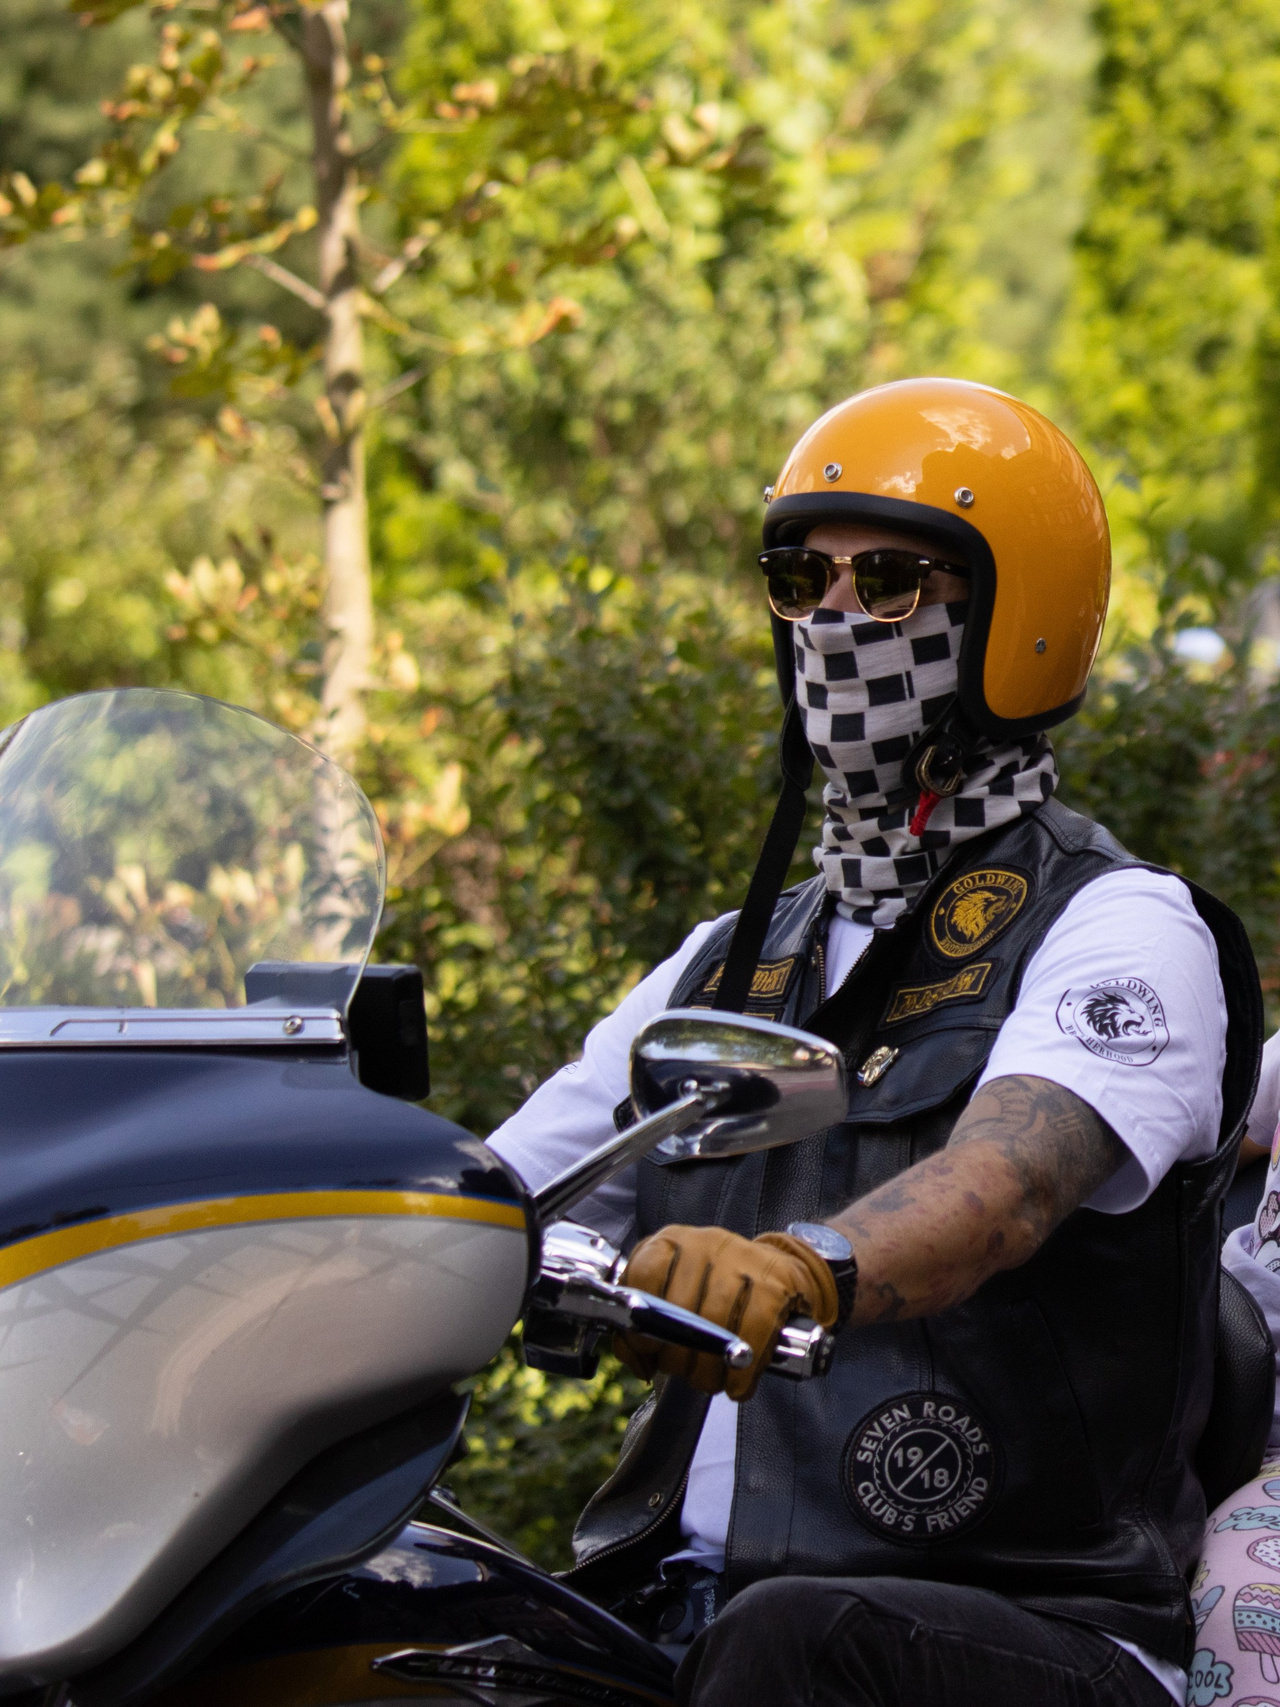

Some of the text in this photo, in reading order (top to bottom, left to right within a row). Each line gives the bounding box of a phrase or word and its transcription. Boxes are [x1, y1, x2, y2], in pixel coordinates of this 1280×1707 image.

[1065, 1025, 1134, 1062] BRHERHOOD
[856, 1401, 990, 1463] SEVEN ROADS
[893, 1447, 924, 1468] 19
[920, 1468, 950, 1489] 18
[857, 1477, 989, 1532] CLUB'S FRIEND
